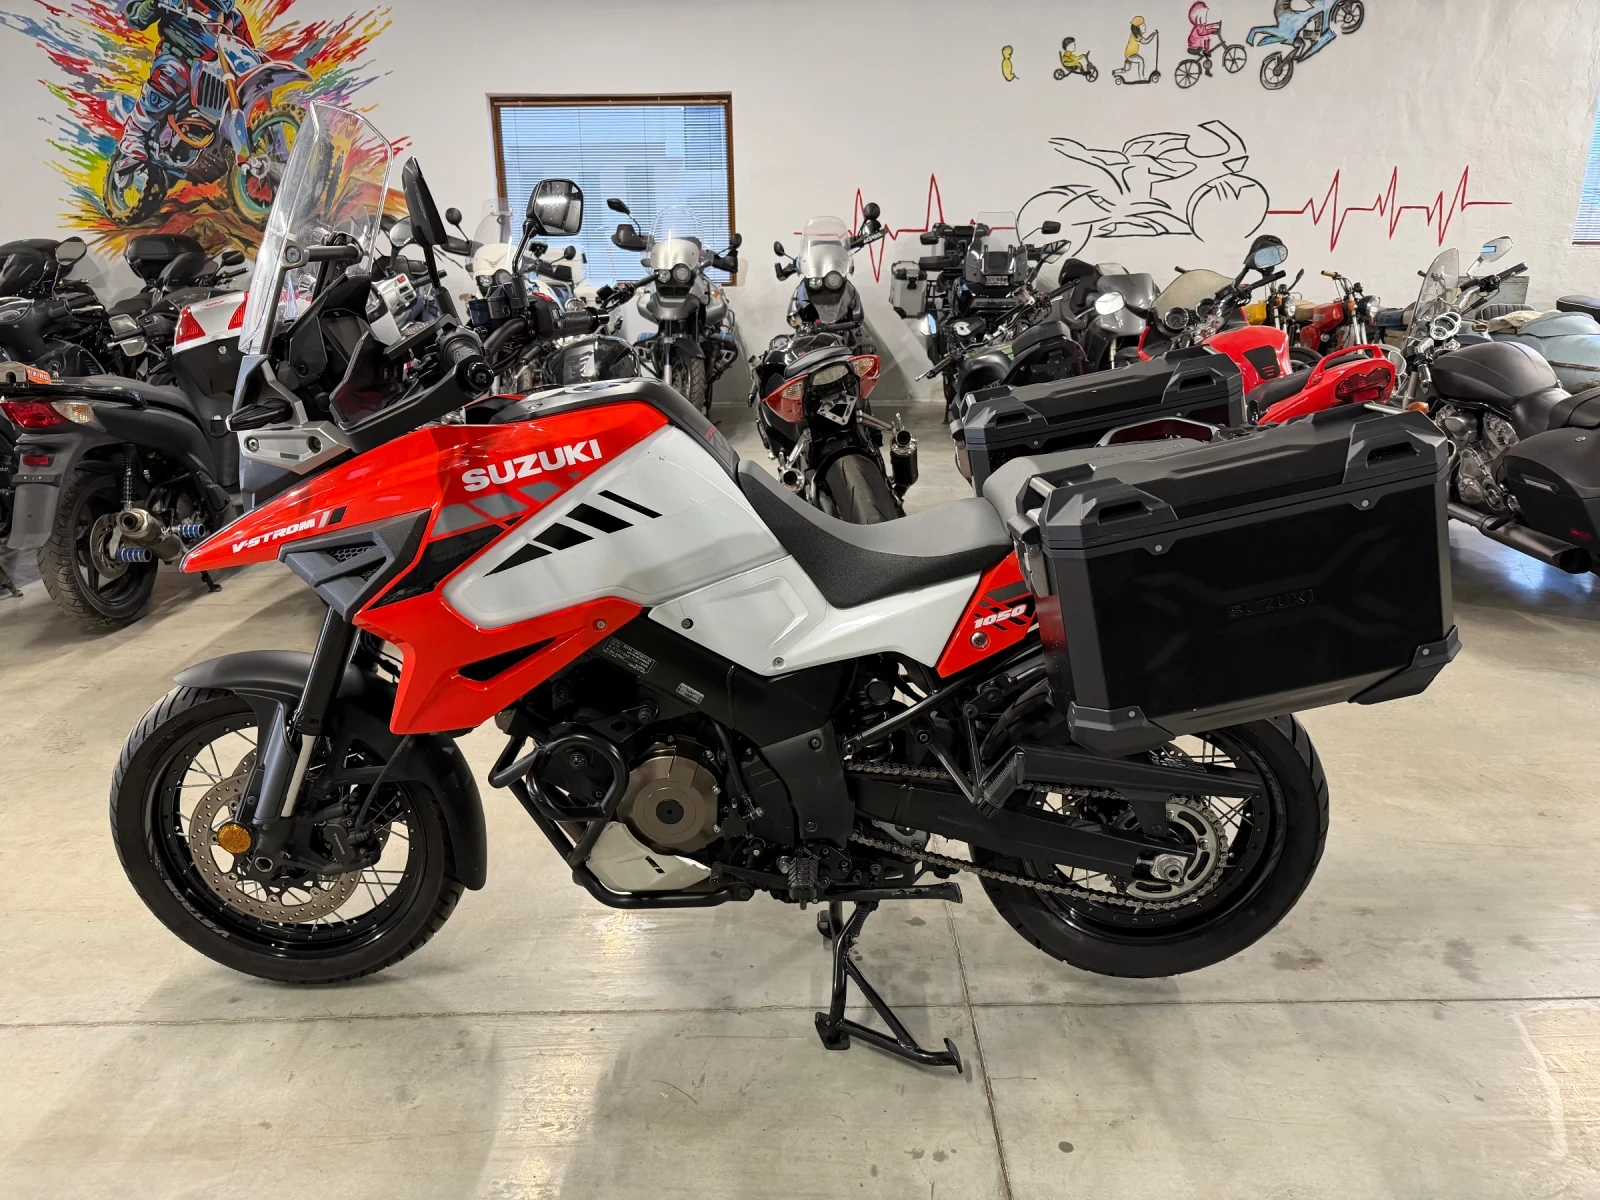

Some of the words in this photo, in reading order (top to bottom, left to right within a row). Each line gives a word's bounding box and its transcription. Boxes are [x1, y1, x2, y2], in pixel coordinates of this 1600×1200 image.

[461, 439, 602, 492] SUZUKI
[232, 518, 315, 553] V-STROM
[974, 604, 1027, 629] 1050
[1228, 589, 1314, 618] SUZUKI
[163, 879, 230, 938] V-STROM
